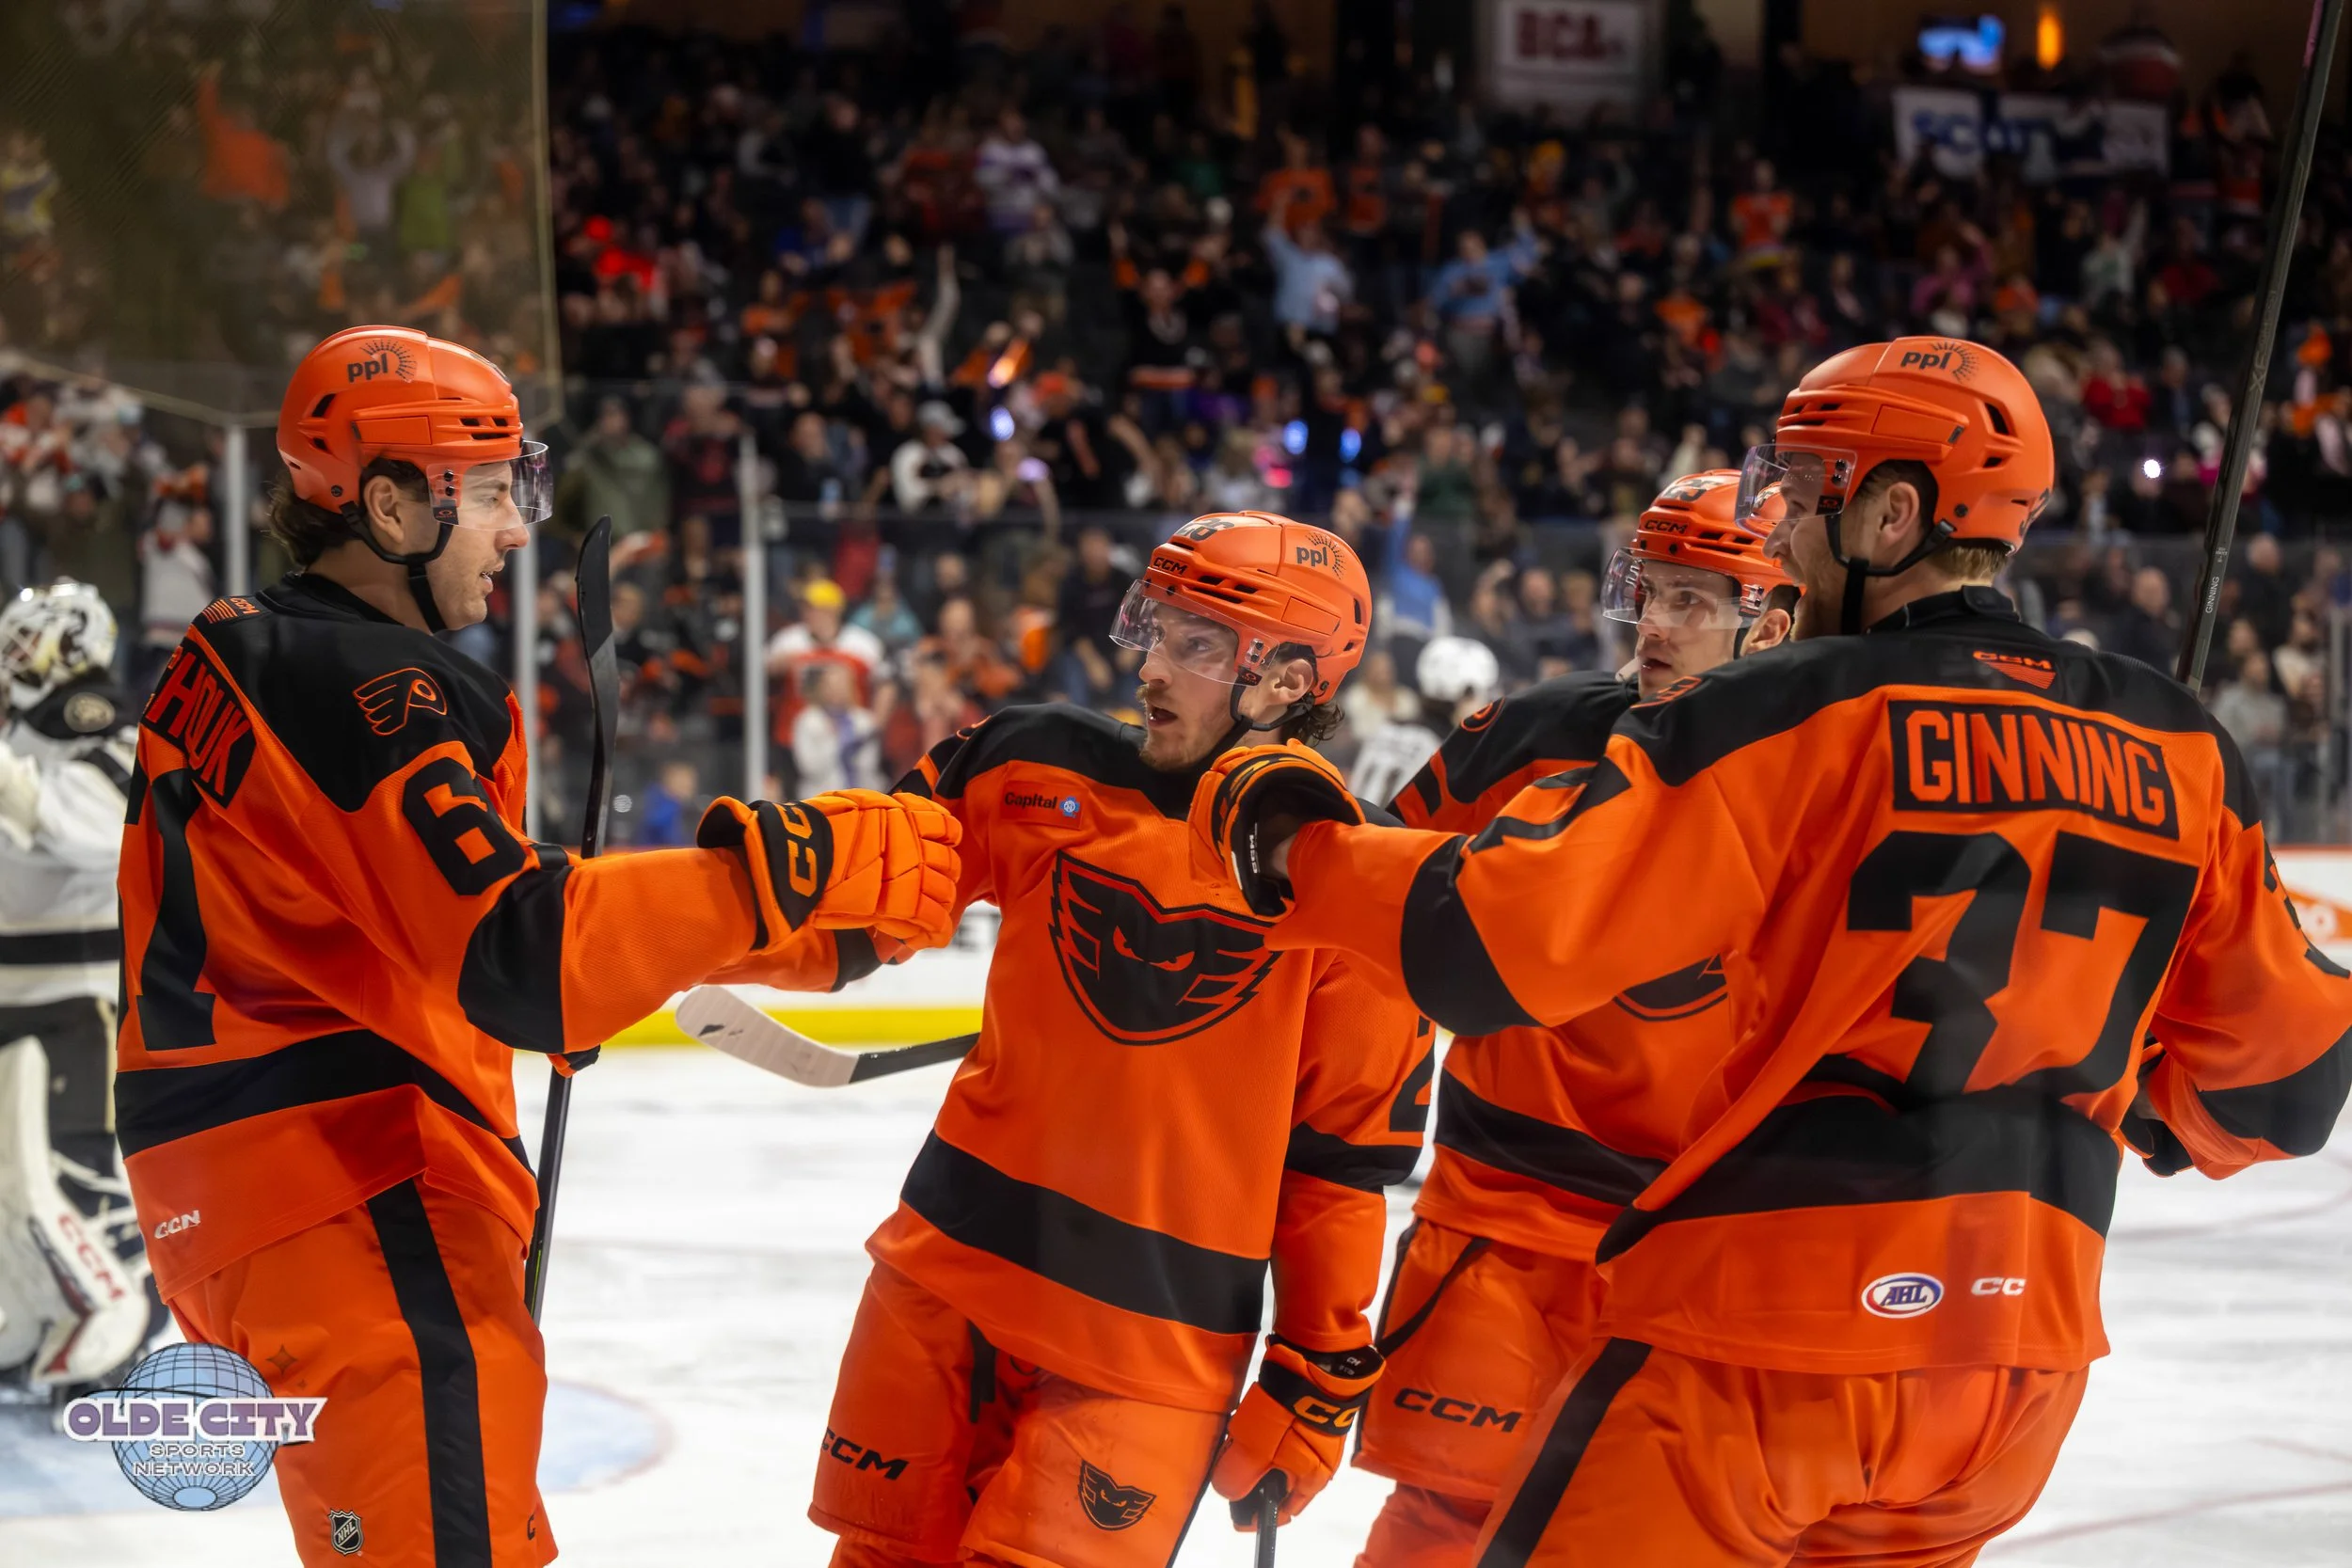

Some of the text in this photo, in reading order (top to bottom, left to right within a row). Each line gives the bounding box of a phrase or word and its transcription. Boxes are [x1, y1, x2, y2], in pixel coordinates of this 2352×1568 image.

[347, 353, 389, 383] ppl
[1900, 351, 1952, 370] ppl
[1644, 519, 1689, 534] CCM
[1153, 557, 1187, 575] CCM
[1295, 546, 1328, 567] ppl
[2205, 576, 2220, 614] GINNING
[1905, 709, 2166, 826] GINNING
[1005, 792, 1058, 810] Capital
[772, 801, 817, 897] CC
[1847, 830, 2200, 1102] 37
[57, 1214, 125, 1302] CCM
[1880, 1284, 1928, 1307] AHL
[1971, 1276, 2026, 1295] CC
[1294, 1396, 1360, 1427] CC
[1393, 1387, 1523, 1433] CCM
[338, 1521, 356, 1544] NHL
